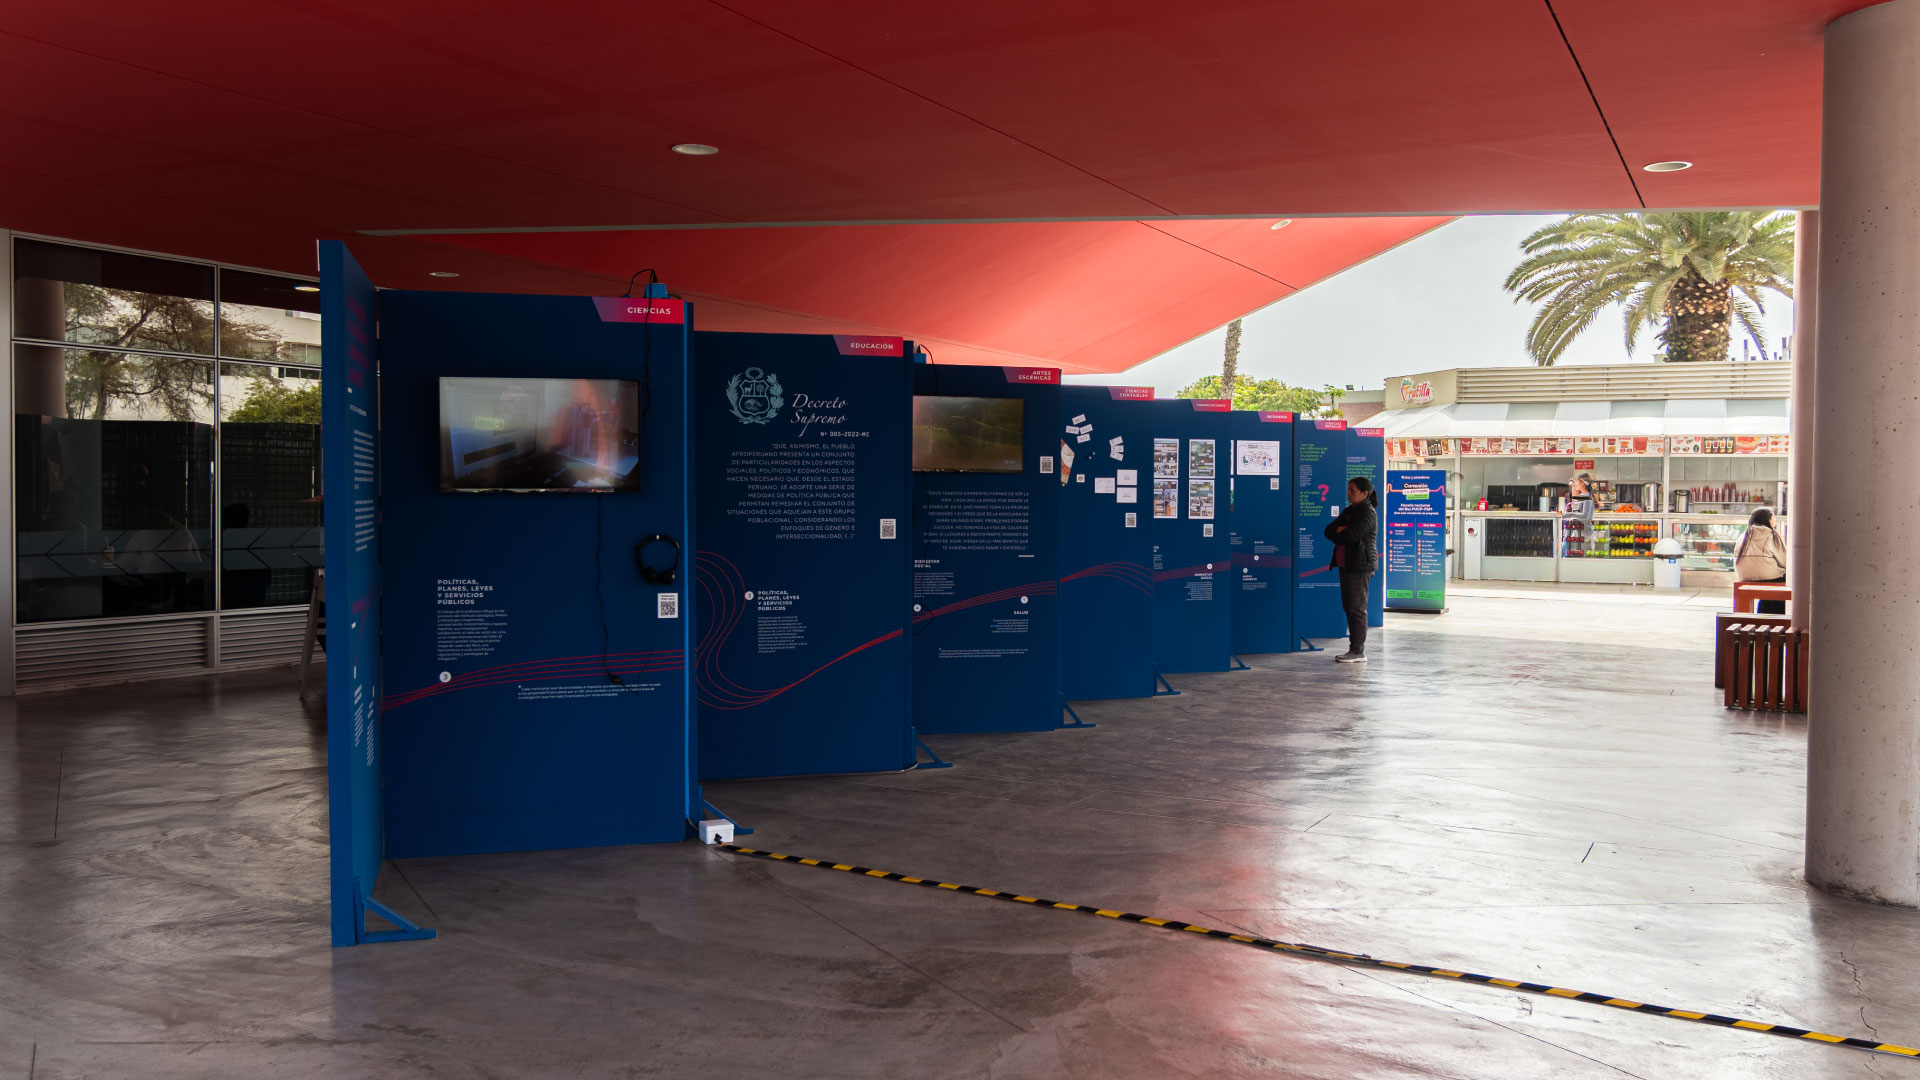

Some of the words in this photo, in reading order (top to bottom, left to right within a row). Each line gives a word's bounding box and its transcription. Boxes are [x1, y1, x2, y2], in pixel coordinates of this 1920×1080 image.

[627, 306, 671, 315] CIENCIAS
[792, 393, 848, 408] Decreto
[791, 409, 848, 437] Supremo
